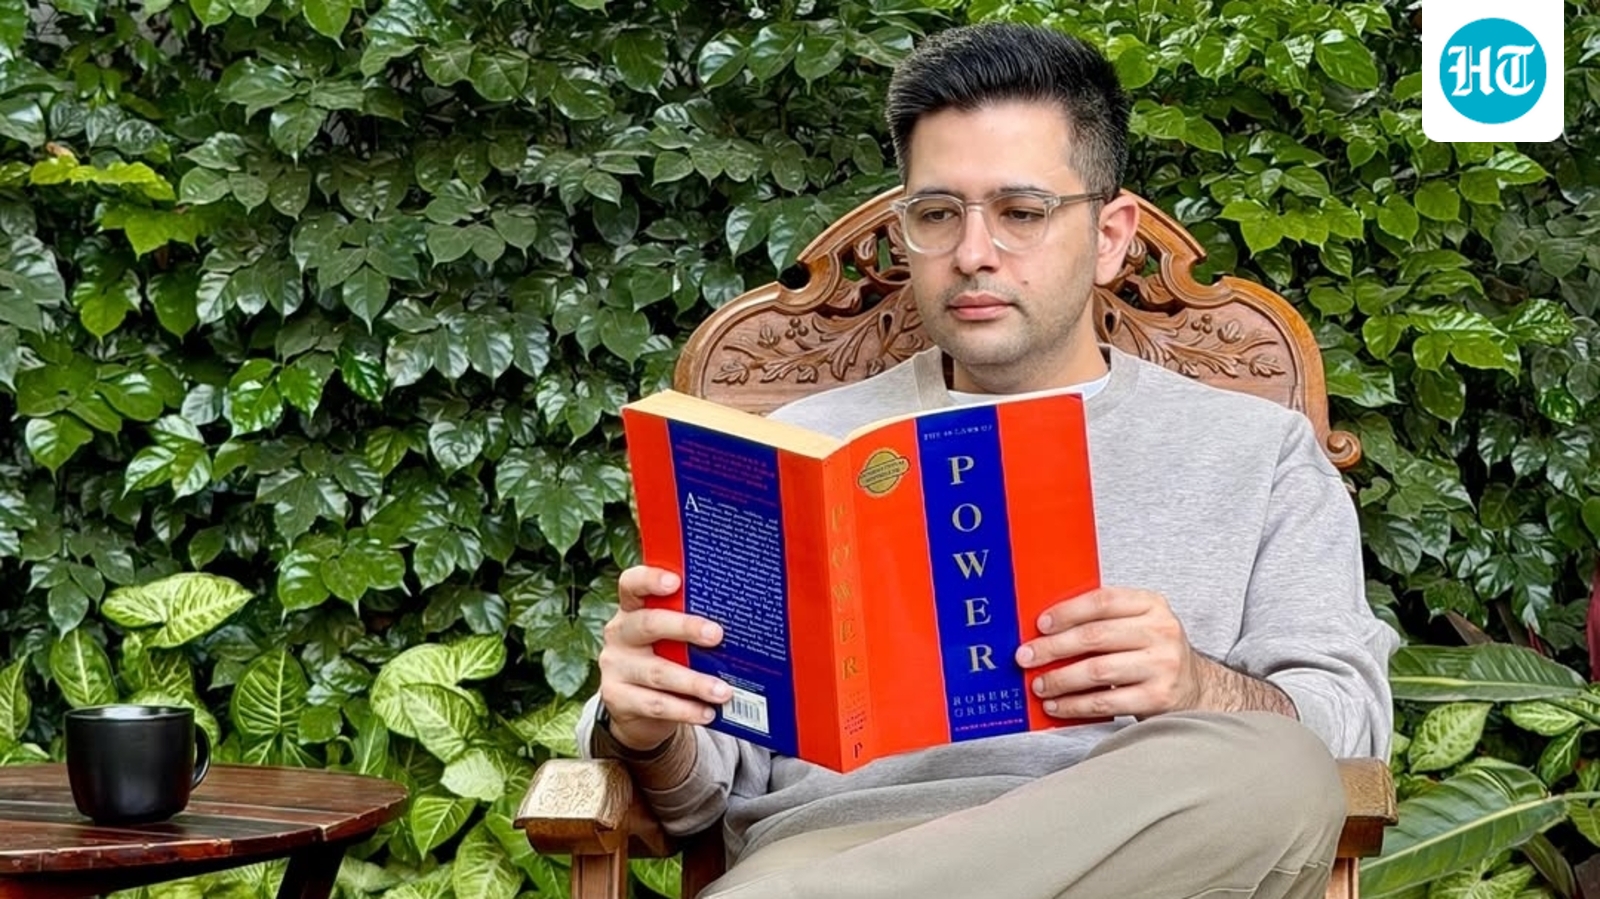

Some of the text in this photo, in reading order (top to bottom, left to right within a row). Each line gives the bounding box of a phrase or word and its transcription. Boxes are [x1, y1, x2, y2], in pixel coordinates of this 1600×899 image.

[947, 455, 998, 673] POWER
[953, 688, 1020, 706] ROBERT
[954, 700, 1023, 718] GREENE
